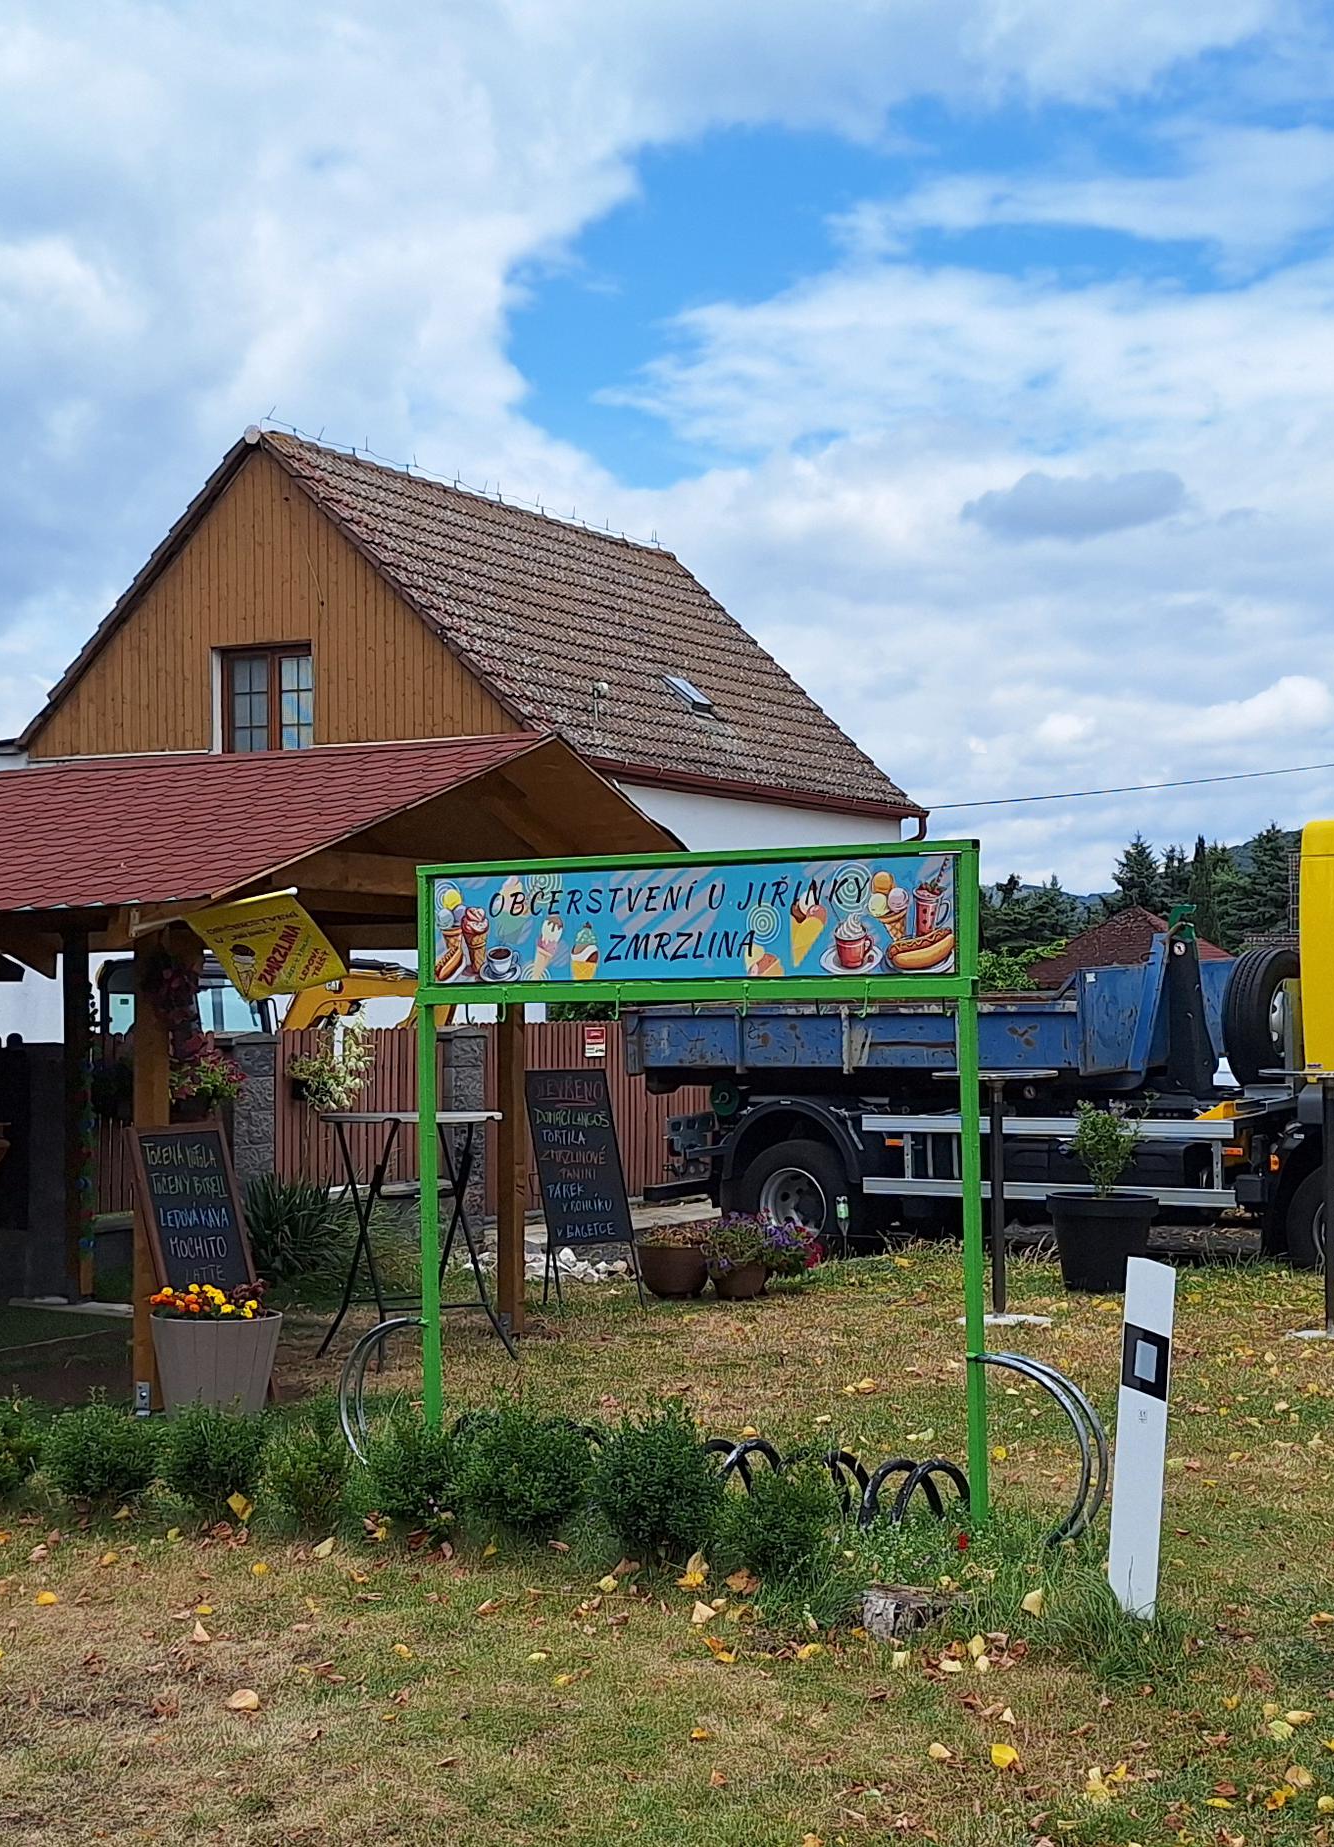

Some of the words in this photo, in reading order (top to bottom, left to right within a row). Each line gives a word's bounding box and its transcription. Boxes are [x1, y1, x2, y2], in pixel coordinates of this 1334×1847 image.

[488, 878, 697, 917] OBČERSTVENÍ
[709, 882, 724, 910] U
[737, 873, 870, 912] JIŘINKY
[257, 924, 301, 987] ZMRZLINA
[603, 929, 756, 964] ZMRZLINA
[325, 980, 341, 991] CAT
[572, 1109, 610, 1129] LANGOŠ
[541, 1129, 587, 1146] TORTILA
[159, 1201, 199, 1230] LEDOVÁ
[200, 1203, 229, 1229] KÁVA
[169, 1235, 228, 1260] MOCHITO
[184, 1264, 227, 1284] LATTE
